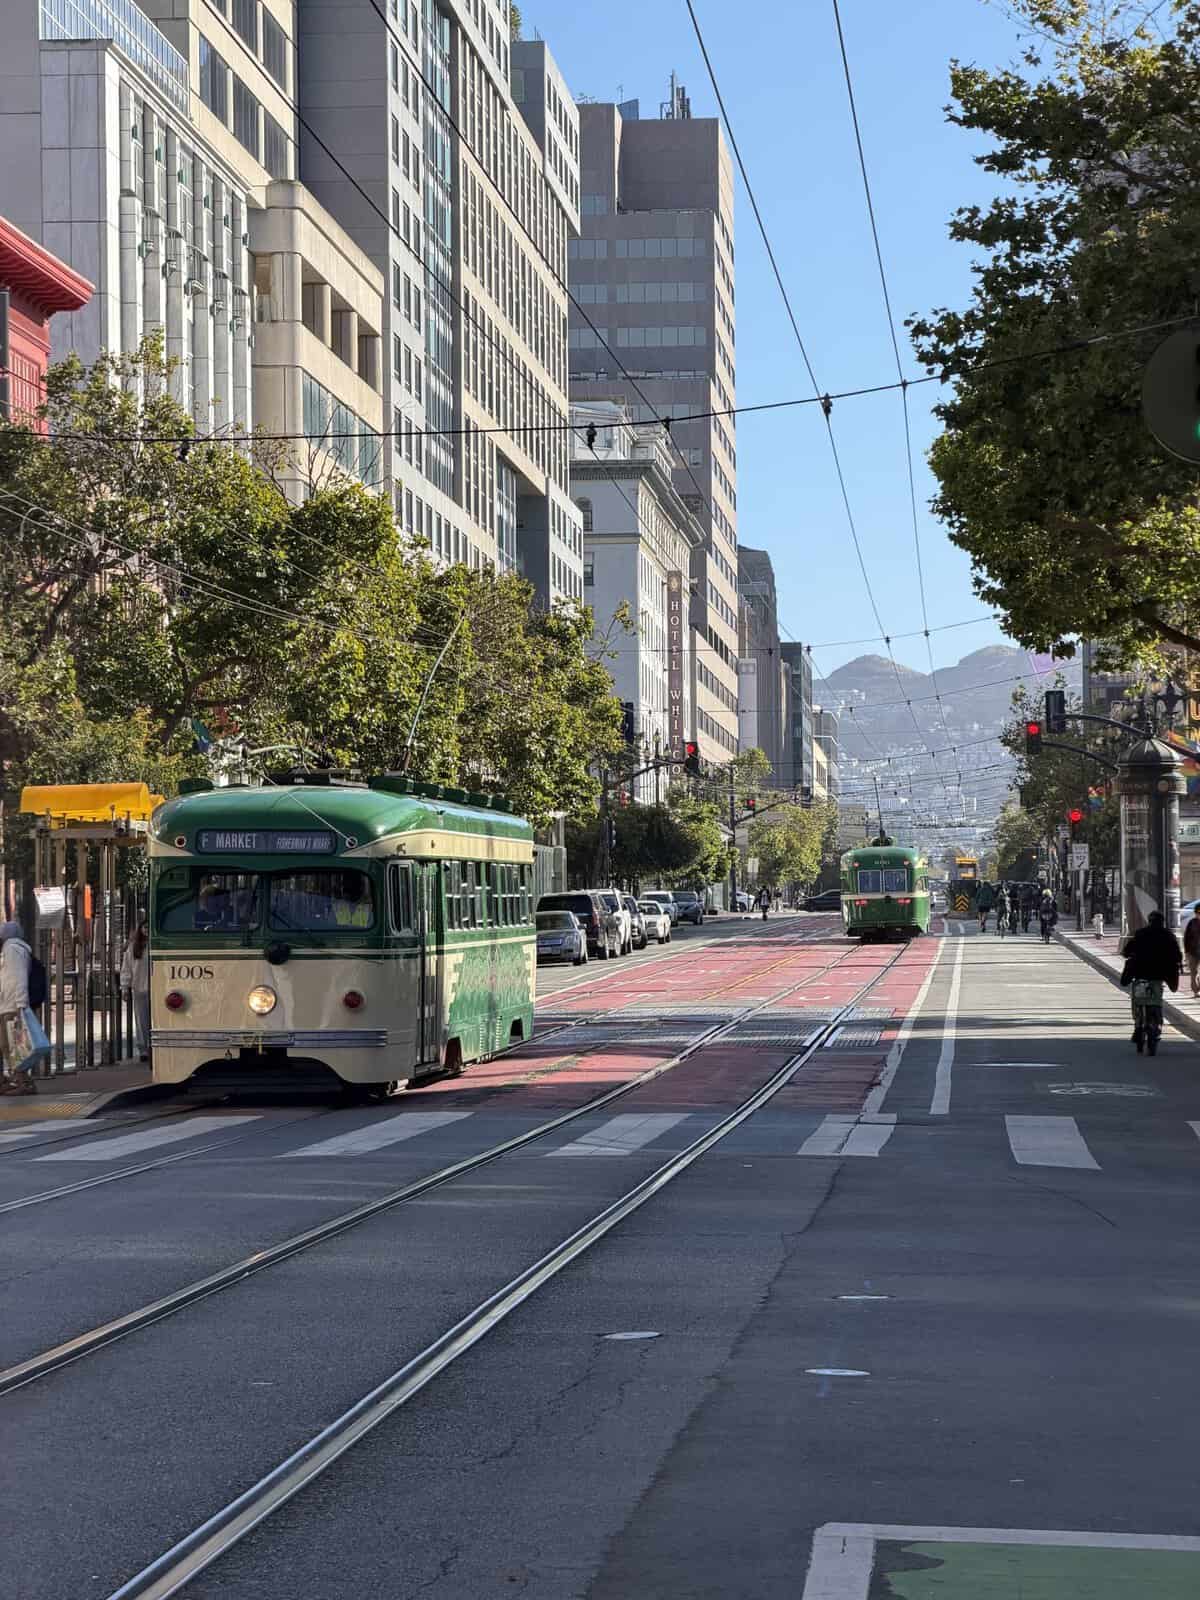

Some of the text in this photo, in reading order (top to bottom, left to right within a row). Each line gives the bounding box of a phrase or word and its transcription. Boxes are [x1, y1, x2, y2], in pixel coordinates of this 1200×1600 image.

[670, 600, 680, 670] HOTEL
[201, 833, 208, 848] F
[216, 833, 257, 848] MARKET
